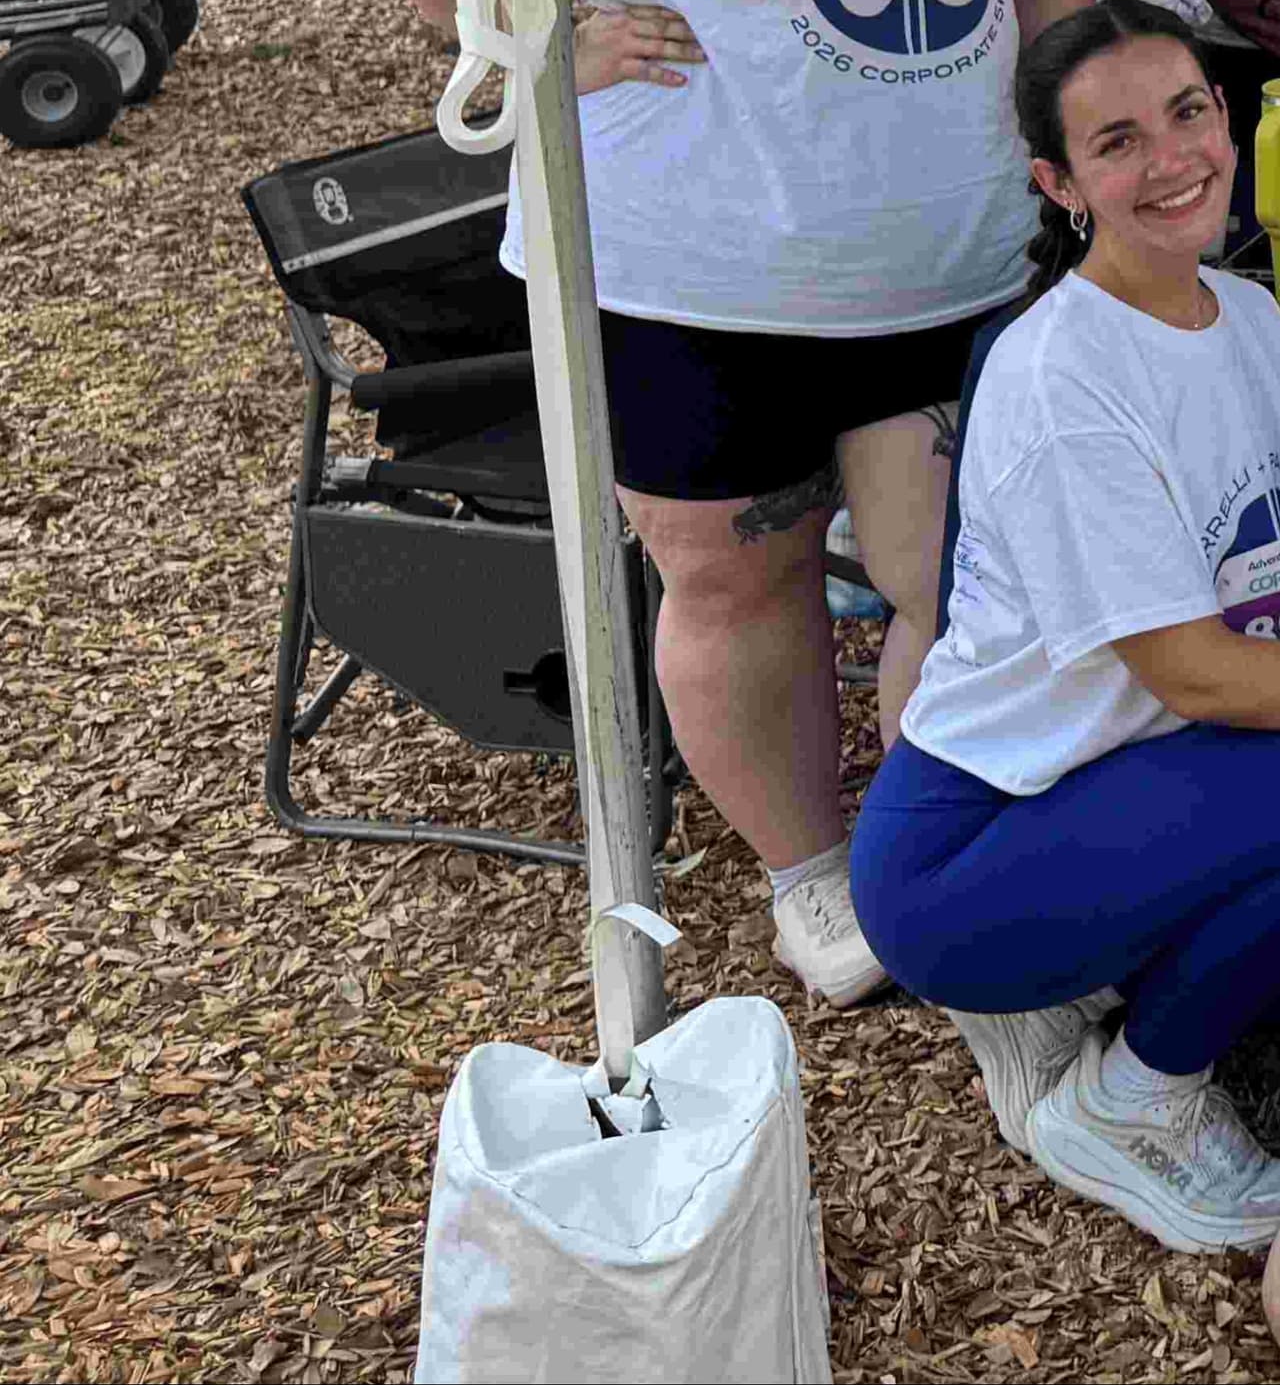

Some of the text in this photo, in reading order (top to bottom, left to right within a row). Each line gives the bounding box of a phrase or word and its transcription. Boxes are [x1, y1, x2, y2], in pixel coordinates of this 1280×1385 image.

[790, 14, 854, 74] 2026
[859, 29, 999, 86] CORPORATE
[1201, 466, 1251, 559] RRELLI
[1128, 1134, 1194, 1194] HOKA
